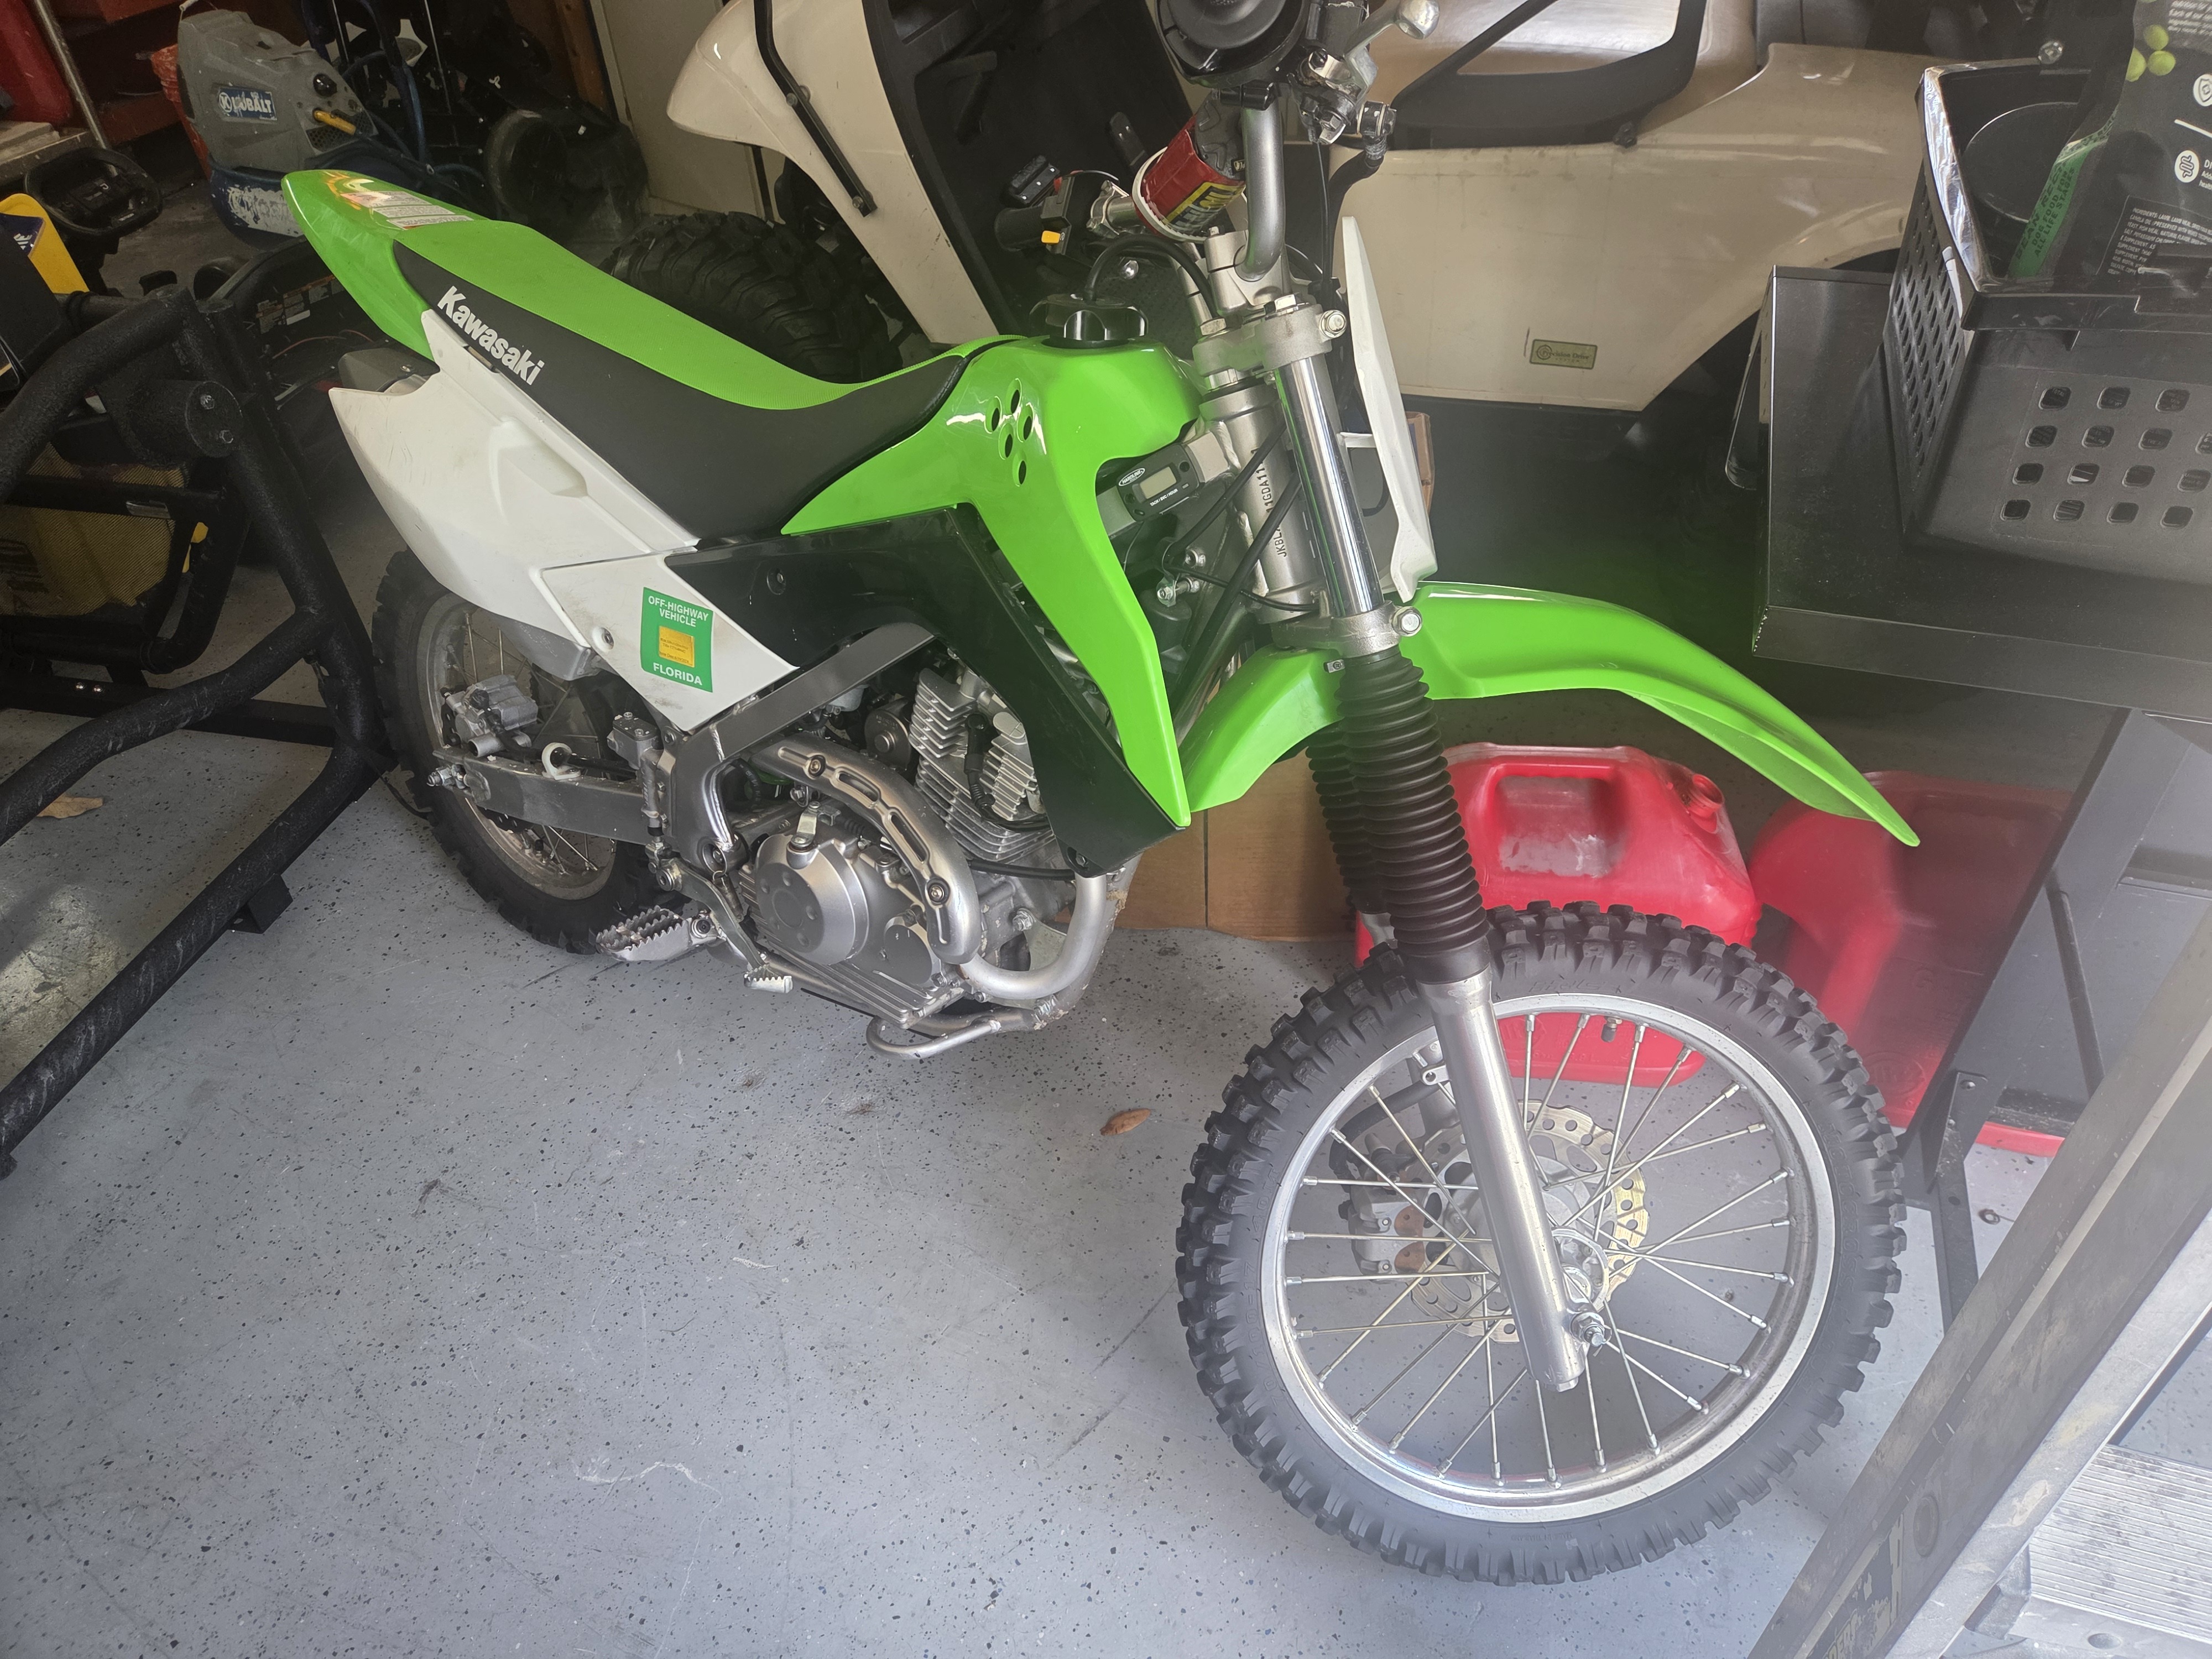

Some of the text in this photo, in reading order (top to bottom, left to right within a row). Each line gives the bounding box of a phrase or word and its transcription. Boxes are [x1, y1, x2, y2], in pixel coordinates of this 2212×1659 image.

[2031, 170, 2068, 246] DOG FOOD FOR
[2034, 167, 2075, 257] ALL LIFE STAGES
[437, 285, 545, 385] Kawasaki
[1572, 352, 1590, 361] Drive
[1168, 488, 1178, 497] HOUR
[648, 595, 709, 622] OFF-HIGHWAY
[659, 608, 696, 628] VEHICLE
[653, 662, 703, 686] FLORIDA
[1818, 1121, 1860, 1292] MOTOCROSS
[1244, 1260, 1286, 1406] 70/100-17
